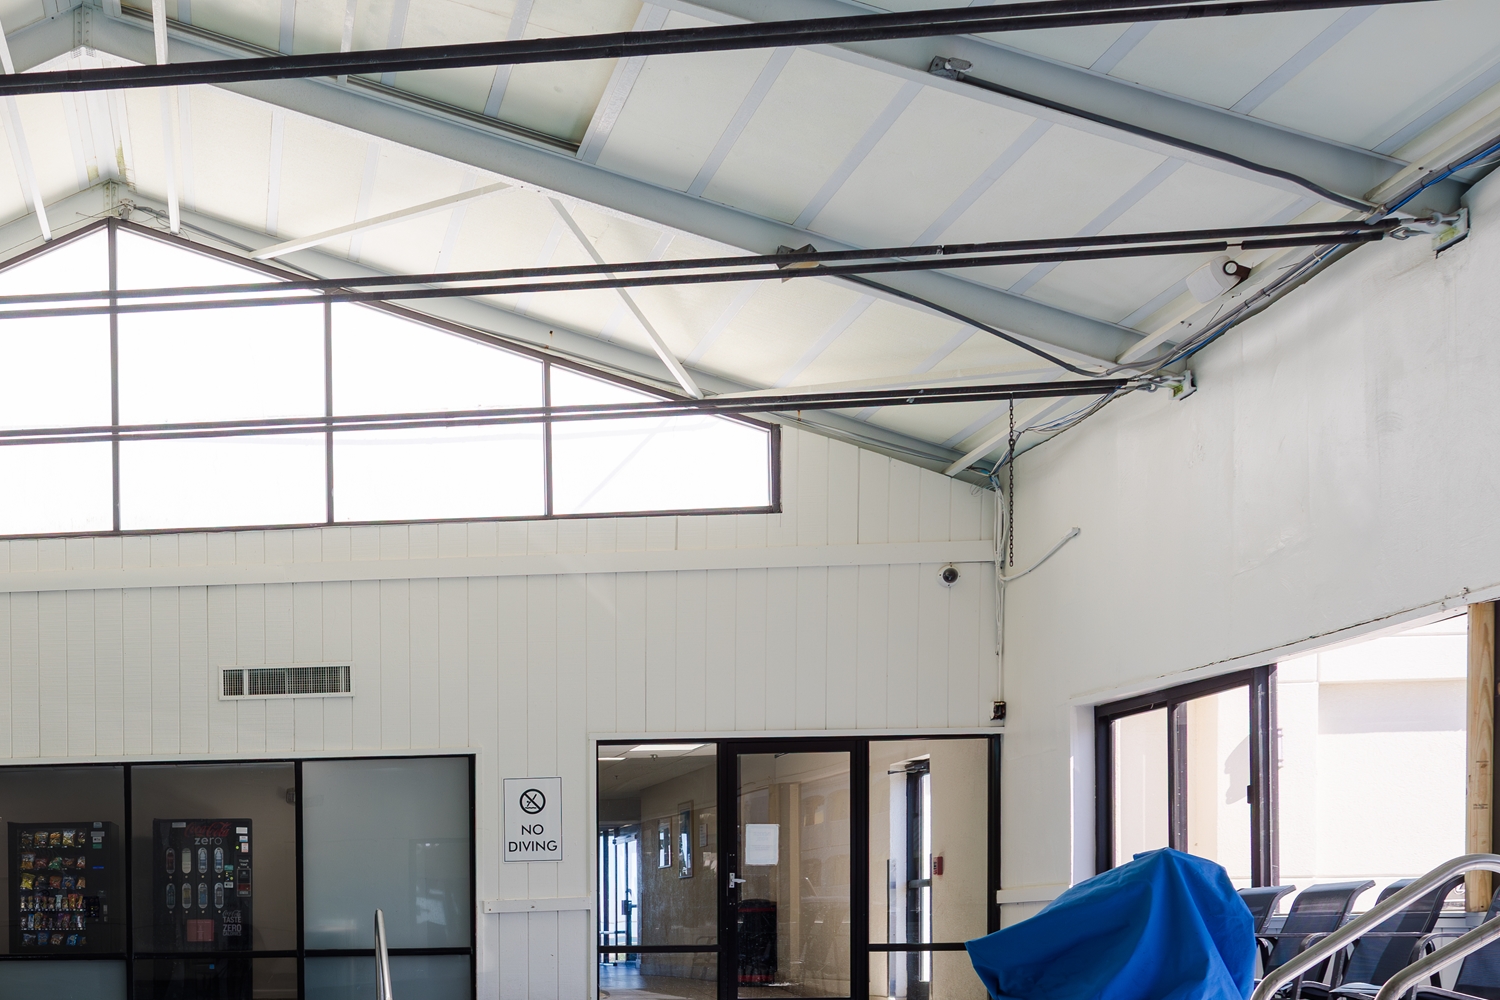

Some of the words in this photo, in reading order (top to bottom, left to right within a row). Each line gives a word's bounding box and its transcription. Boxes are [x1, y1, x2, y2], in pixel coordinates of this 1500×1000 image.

[184, 821, 232, 837] Coca-Cola
[521, 824, 544, 835] NO
[194, 836, 223, 845] zero
[508, 840, 558, 852] DIVING
[222, 924, 242, 932] ZERO
